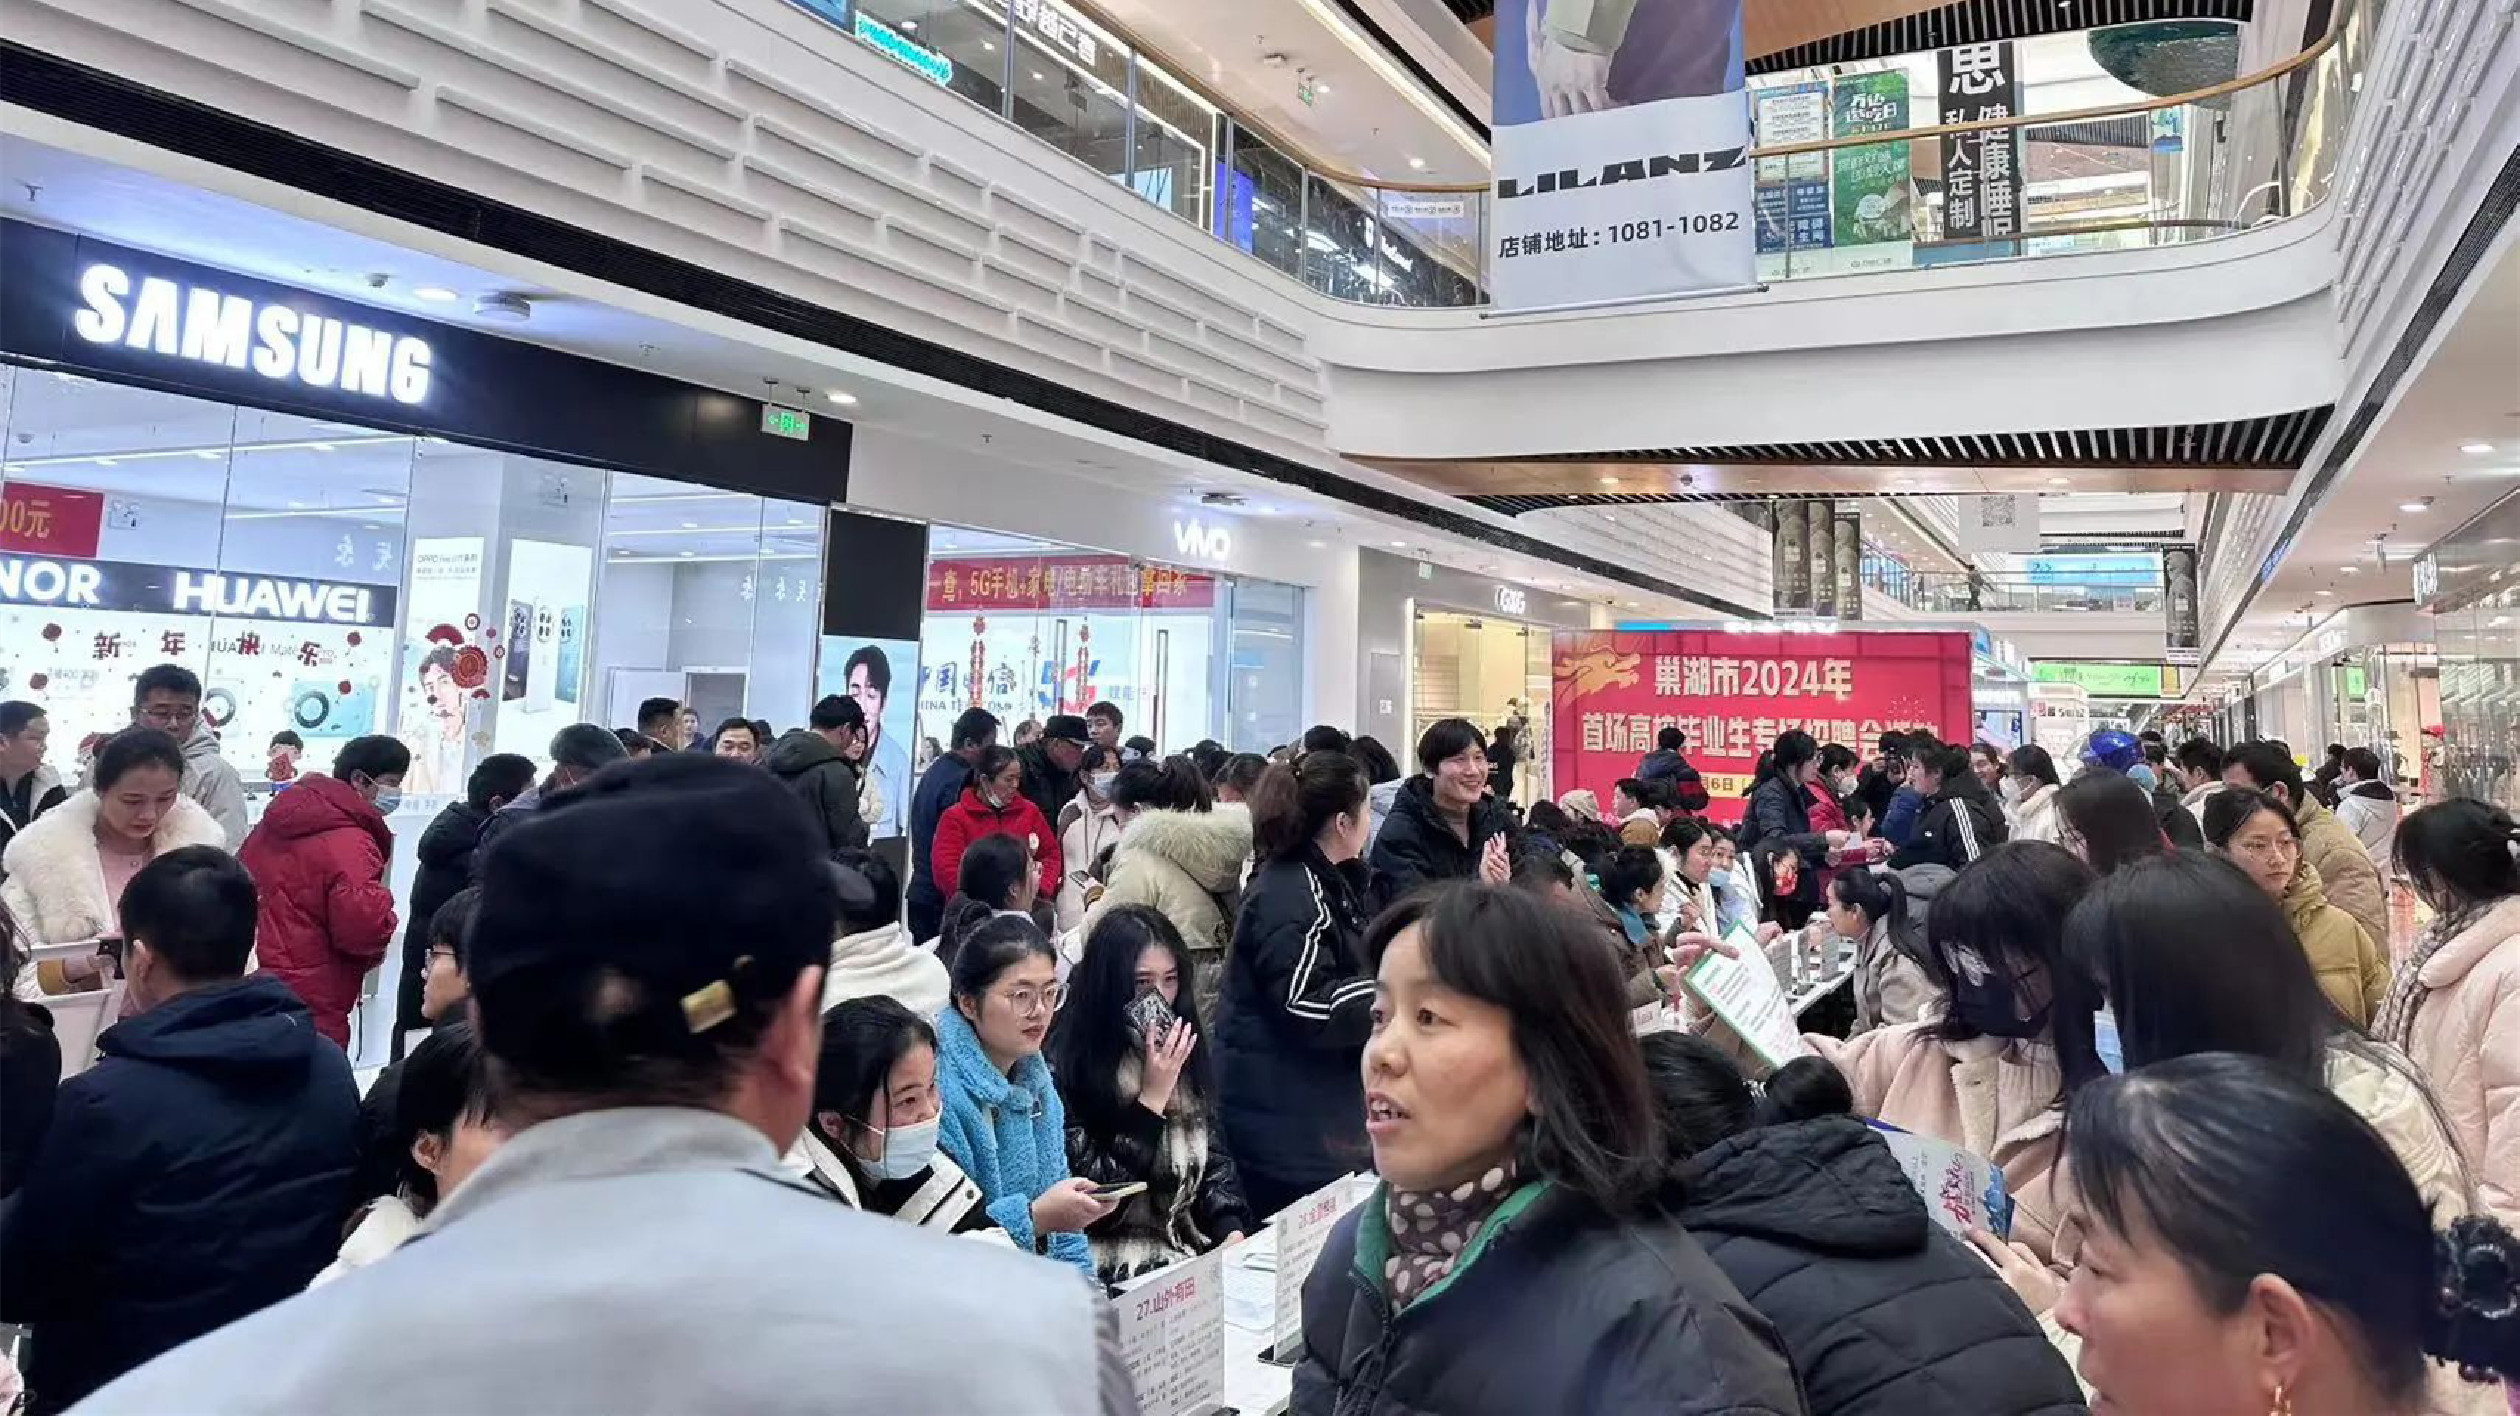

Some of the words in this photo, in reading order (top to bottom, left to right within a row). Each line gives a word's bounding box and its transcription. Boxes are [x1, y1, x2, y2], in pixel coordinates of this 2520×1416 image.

[1497, 145, 1747, 199] LILANZ
[75, 263, 432, 404] SAMSUNG
[173, 571, 370, 623] HUAWEI
[1654, 656, 1853, 698] 巢湖市2024年
